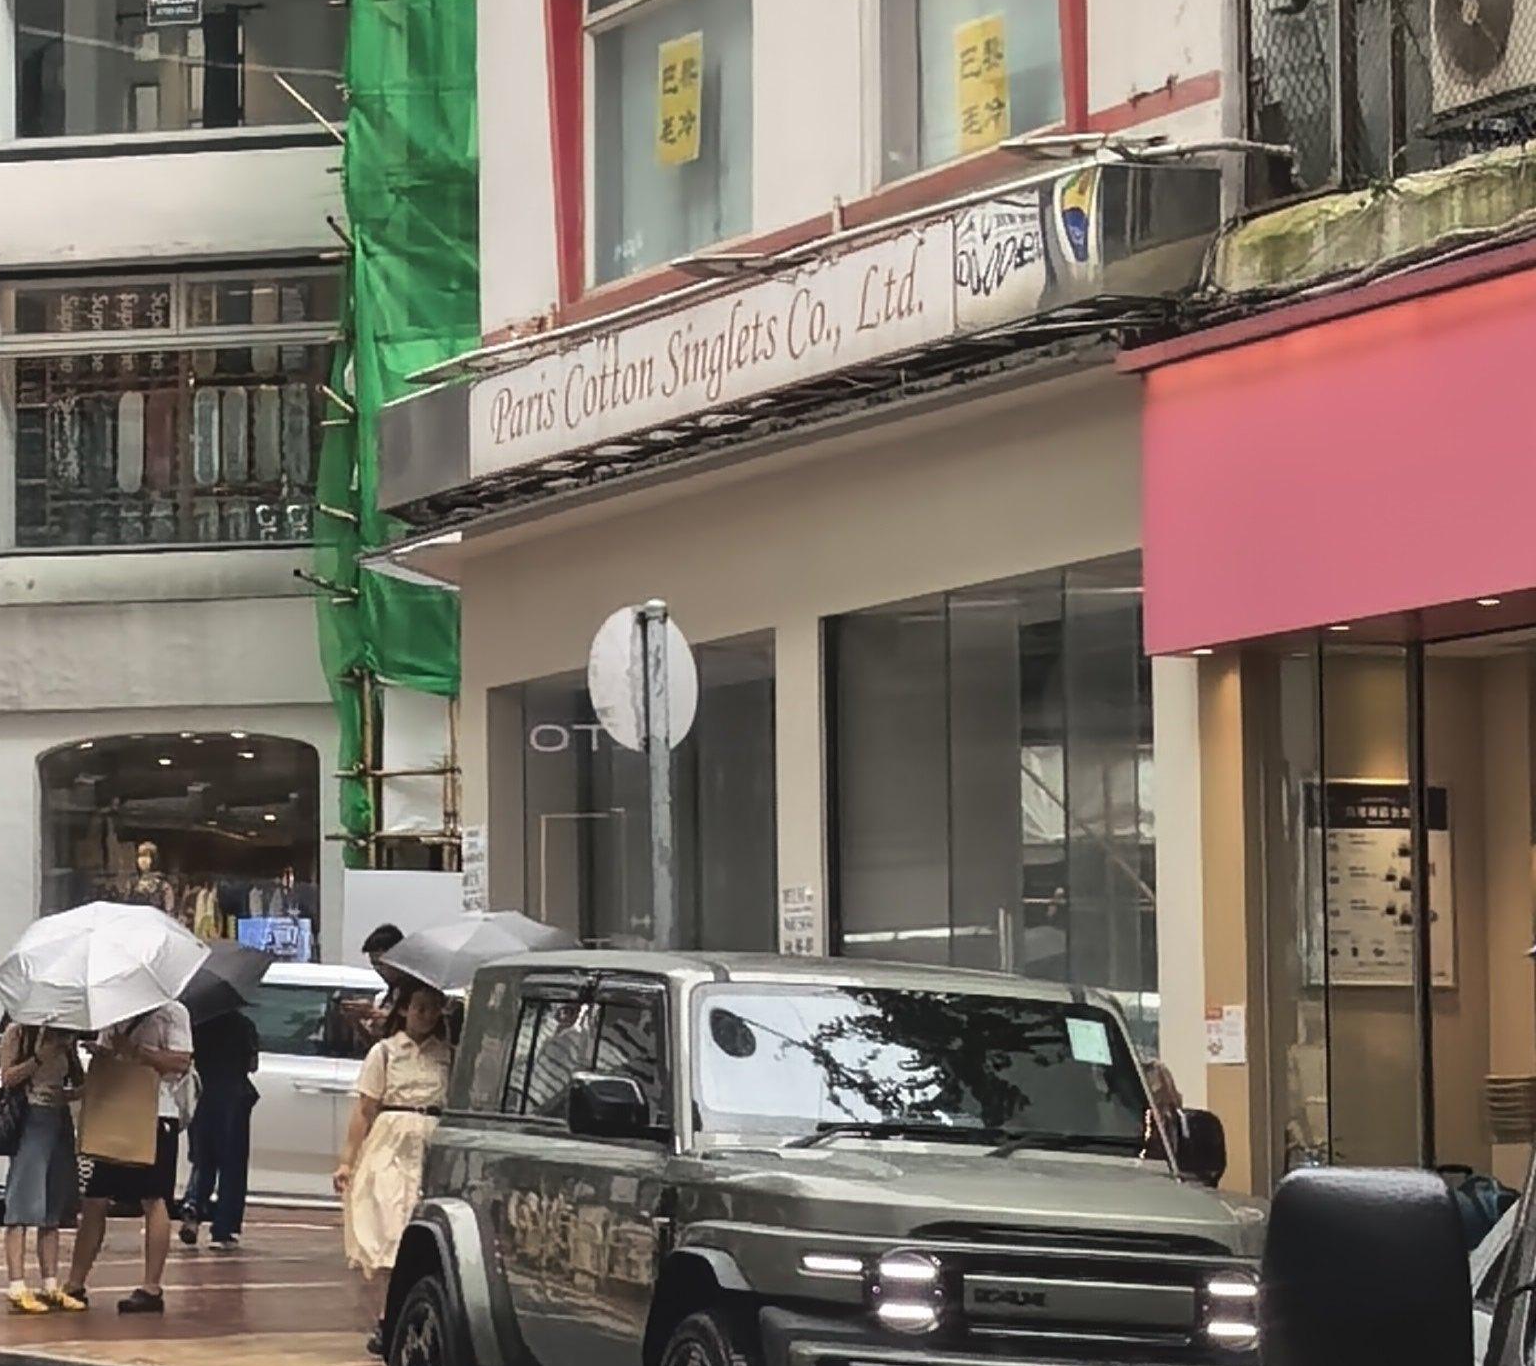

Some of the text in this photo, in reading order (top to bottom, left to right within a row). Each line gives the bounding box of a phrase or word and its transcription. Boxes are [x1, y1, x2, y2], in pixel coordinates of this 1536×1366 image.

[490, 373, 557, 445] Paris
[564, 357, 654, 430] Cotton
[662, 299, 777, 403] Singlets
[855, 245, 924, 332] Ltd.
